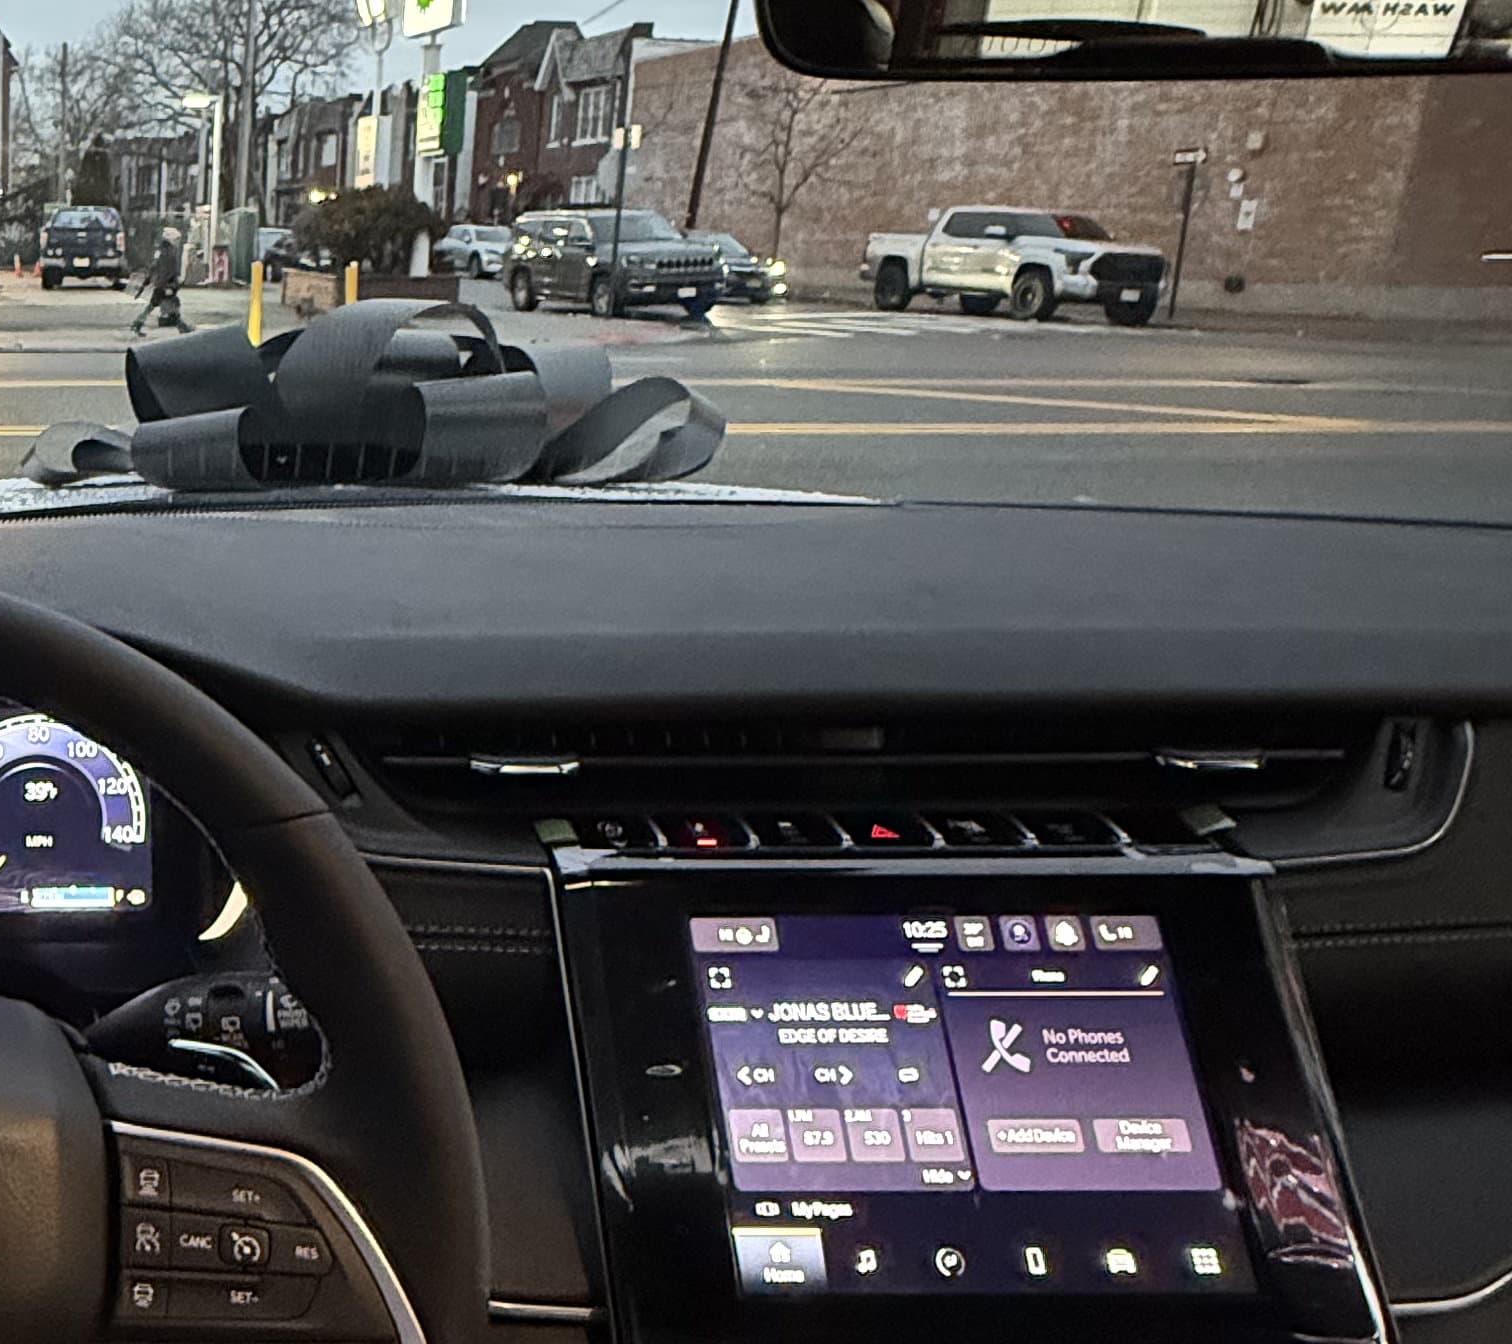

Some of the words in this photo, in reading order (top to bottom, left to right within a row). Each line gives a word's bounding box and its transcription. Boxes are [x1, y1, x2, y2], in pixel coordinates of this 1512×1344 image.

[27, 726, 50, 742] 80
[67, 741, 98, 758] 100
[97, 778, 129, 795] 120
[103, 826, 134, 843] 140
[902, 920, 948, 939] 10:25
[768, 1002, 830, 1022] JONAS
[777, 1028, 817, 1044] EDGE
[818, 1028, 837, 1044] OF
[838, 1028, 889, 1044] DESIRE
[1042, 1029, 1066, 1045] No
[1068, 1028, 1125, 1045] Phones
[1046, 1047, 1131, 1063] Connected
[1035, 1128, 1076, 1144] Device
[1118, 1120, 1163, 1135] Device
[1115, 1135, 1173, 1153] Manager
[179, 1233, 213, 1250] CANC
[295, 1245, 318, 1260] RES
[763, 1268, 805, 1284] Home
